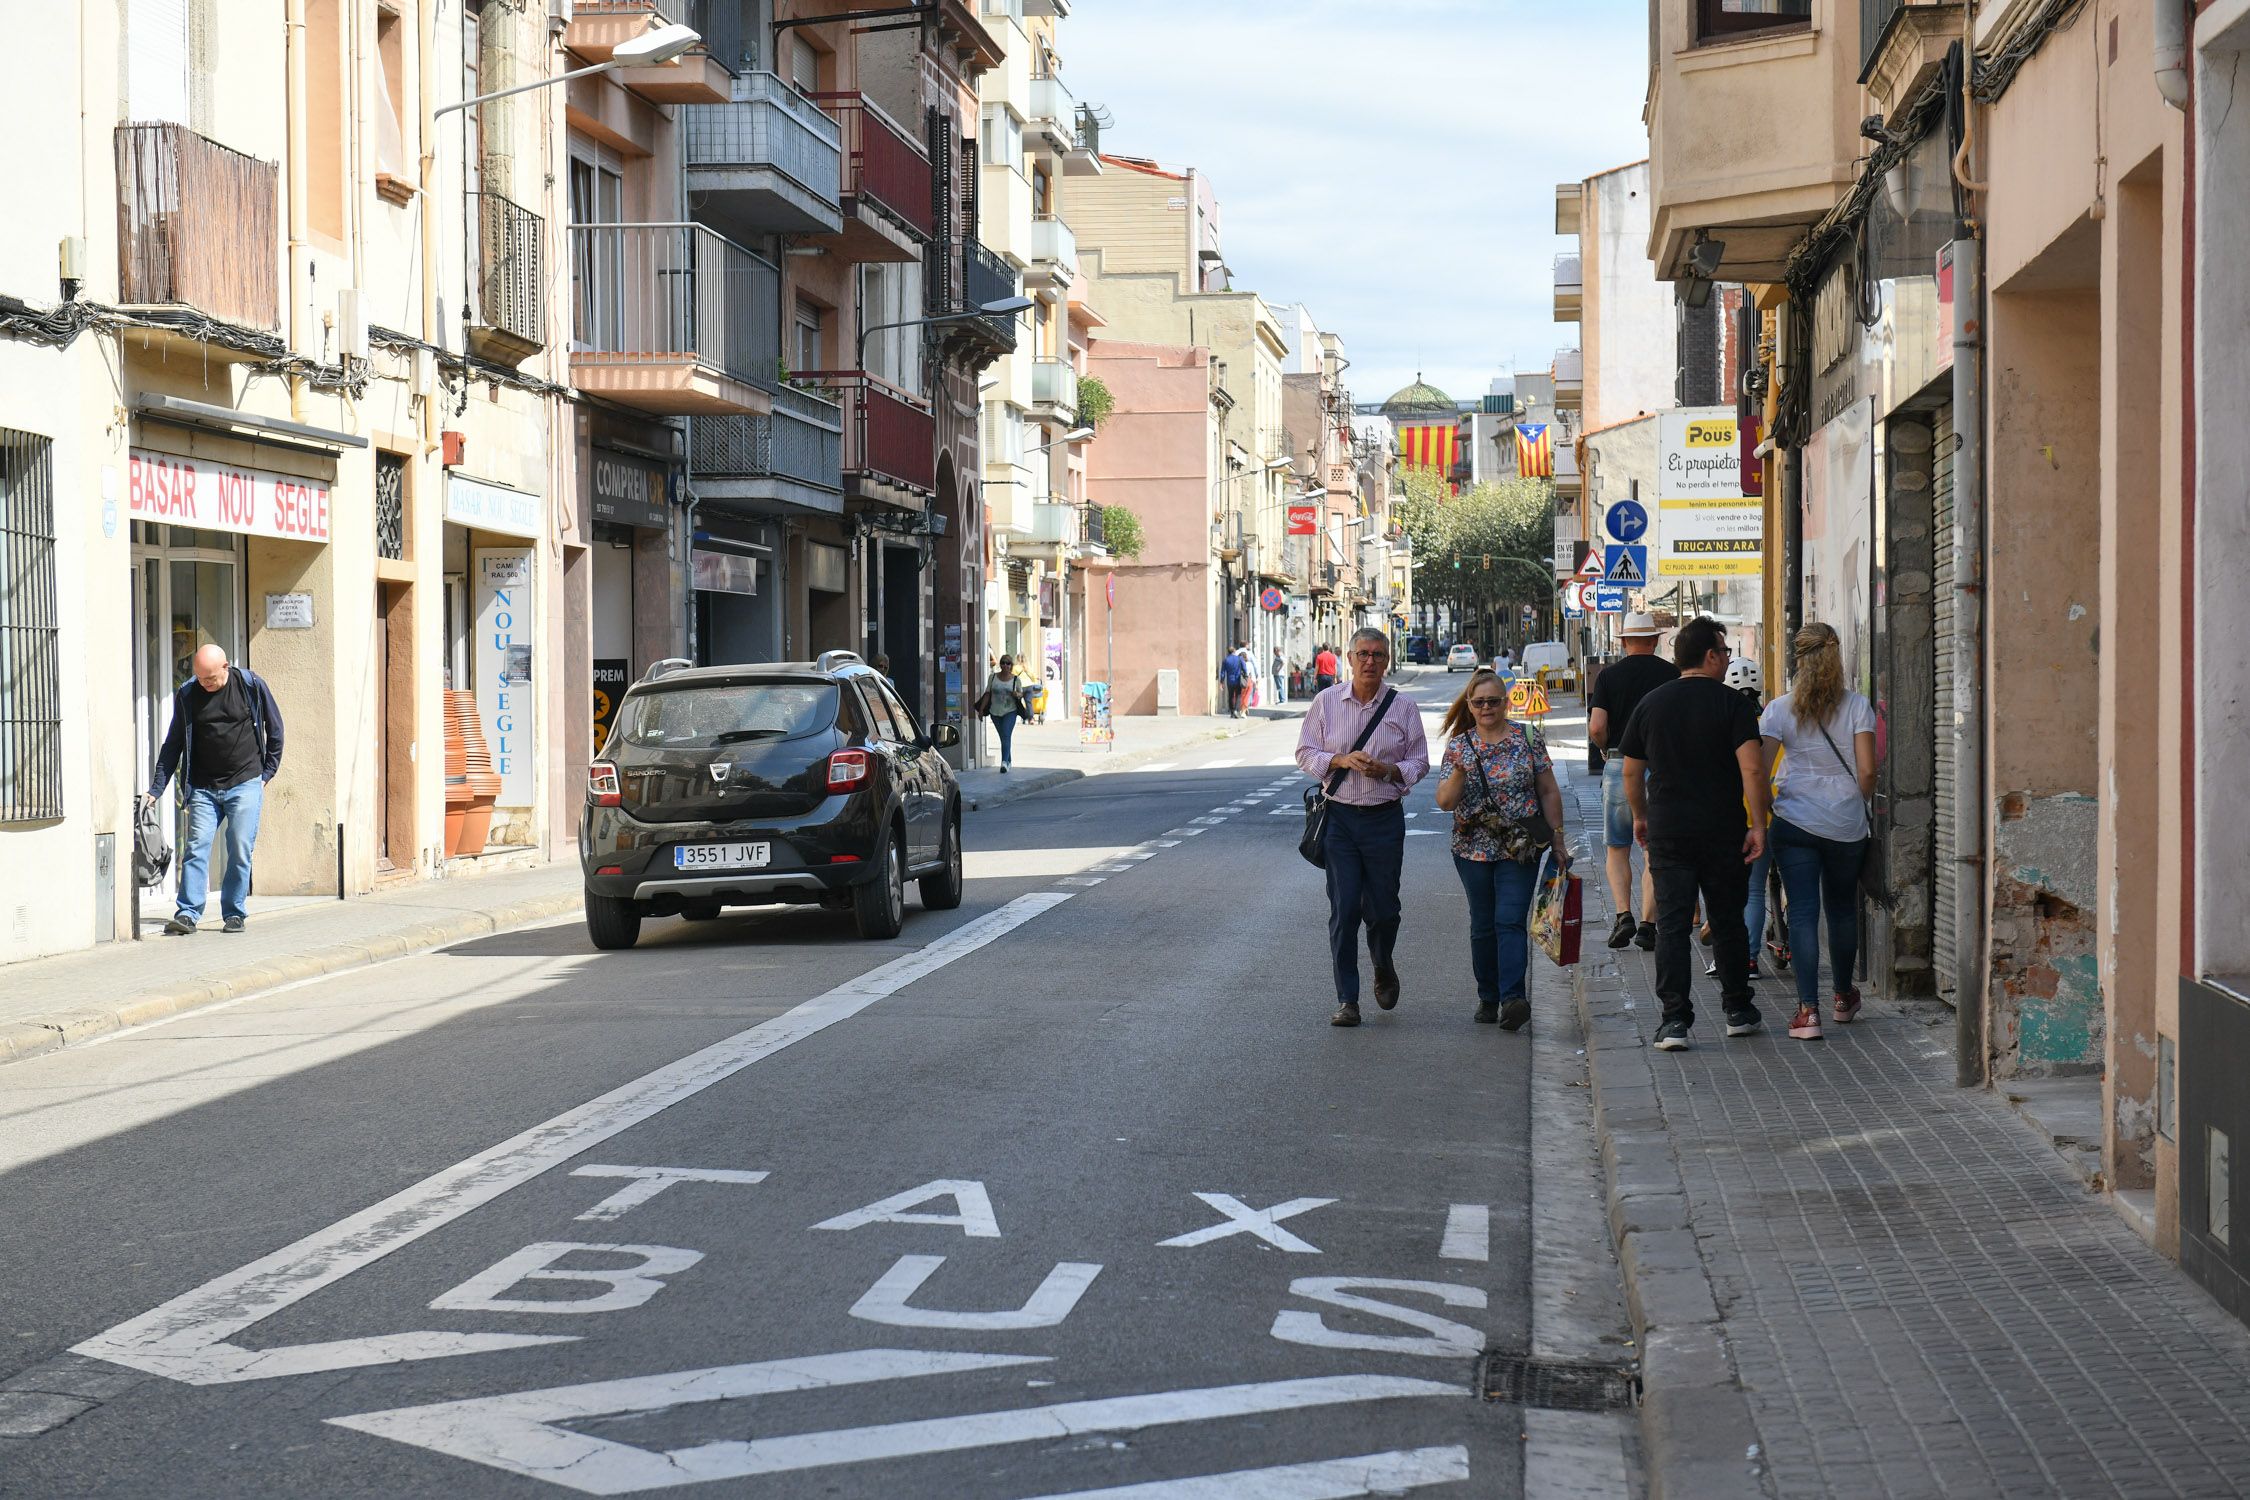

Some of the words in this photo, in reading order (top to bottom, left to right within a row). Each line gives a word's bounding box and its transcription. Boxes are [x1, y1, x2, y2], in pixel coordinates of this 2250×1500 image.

[1668, 453, 1683, 471] Ei
[596, 460, 648, 503] COMPREM
[649, 471, 664, 507] OR
[1712, 480, 1719, 488] el
[129, 455, 196, 519] BASAR
[218, 471, 255, 526] NOU
[274, 479, 327, 537] SEGLE
[1718, 500, 1747, 508] persones
[453, 485, 482, 517] BASAR
[488, 494, 506, 520] NOU
[511, 498, 535, 528] SEGLE
[1716, 513, 1741, 521] vendre
[1557, 544, 1565, 552] EN
[1678, 541, 1730, 551] TRUCA'NS
[1733, 540, 1755, 550] ARA
[494, 590, 513, 651] NOU
[1512, 691, 1524, 701] 20
[496, 671, 513, 775] SEGLE
[627, 769, 667, 777] SANDERO
[687, 846, 726, 863] 3551
[735, 845, 766, 862] JVF
[567, 1163, 1490, 1262] TAXI
[427, 1240, 1488, 1358] BUS
